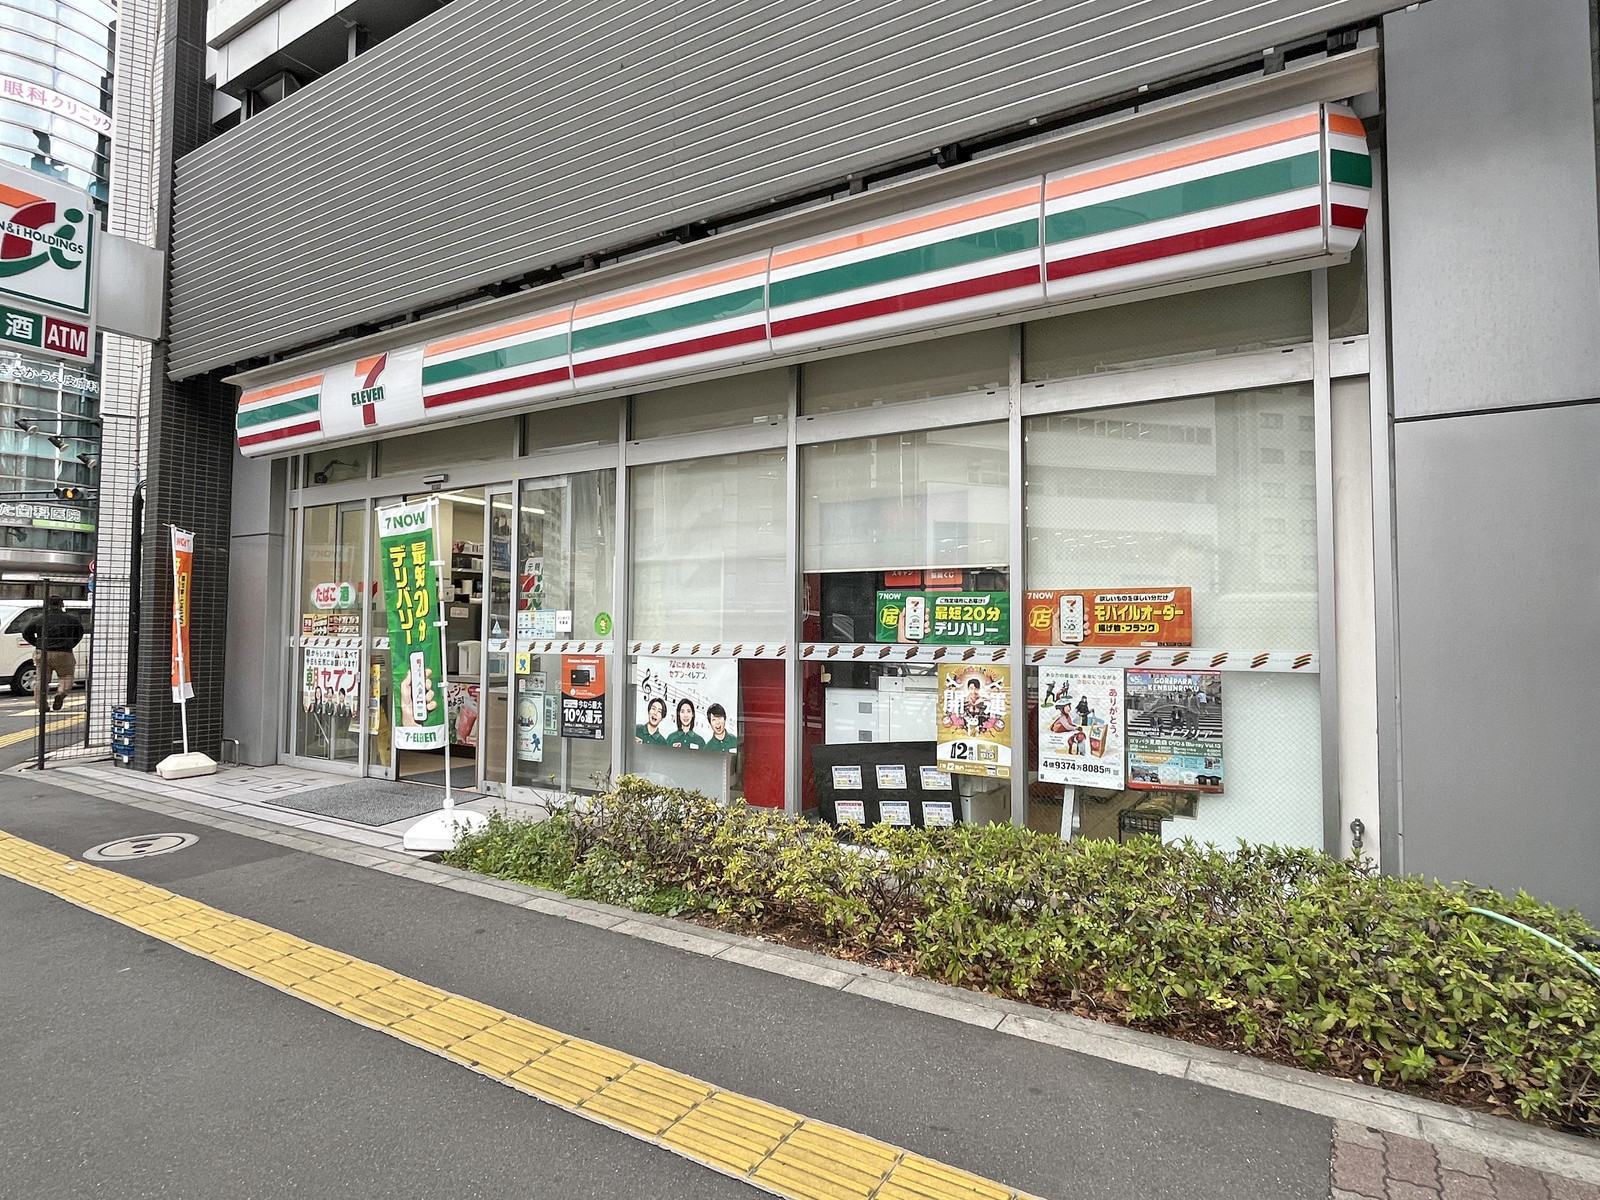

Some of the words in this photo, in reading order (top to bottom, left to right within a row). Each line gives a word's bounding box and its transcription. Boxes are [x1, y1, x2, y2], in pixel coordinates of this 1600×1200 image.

[3, 79, 112, 131] 眼科クリニック
[23, 229, 84, 254] HOLDINGS
[5, 312, 35, 340] 酒
[47, 324, 86, 352] ATM
[385, 511, 425, 529] 7NOW
[315, 587, 336, 602] たばこ
[340, 586, 350, 602] 酒
[389, 543, 415, 646] デリバリー
[1027, 592, 1054, 600] 7NOW
[935, 606, 1001, 621] 最短20分
[1030, 608, 1054, 628] 店
[1094, 604, 1184, 621] モバイルオーダー
[934, 622, 999, 637] デリバリー
[306, 666, 357, 692] 朝セブン
[578, 700, 603, 710] 今なら最大
[563, 708, 603, 724] 10%還元
[950, 742, 968, 760] 12
